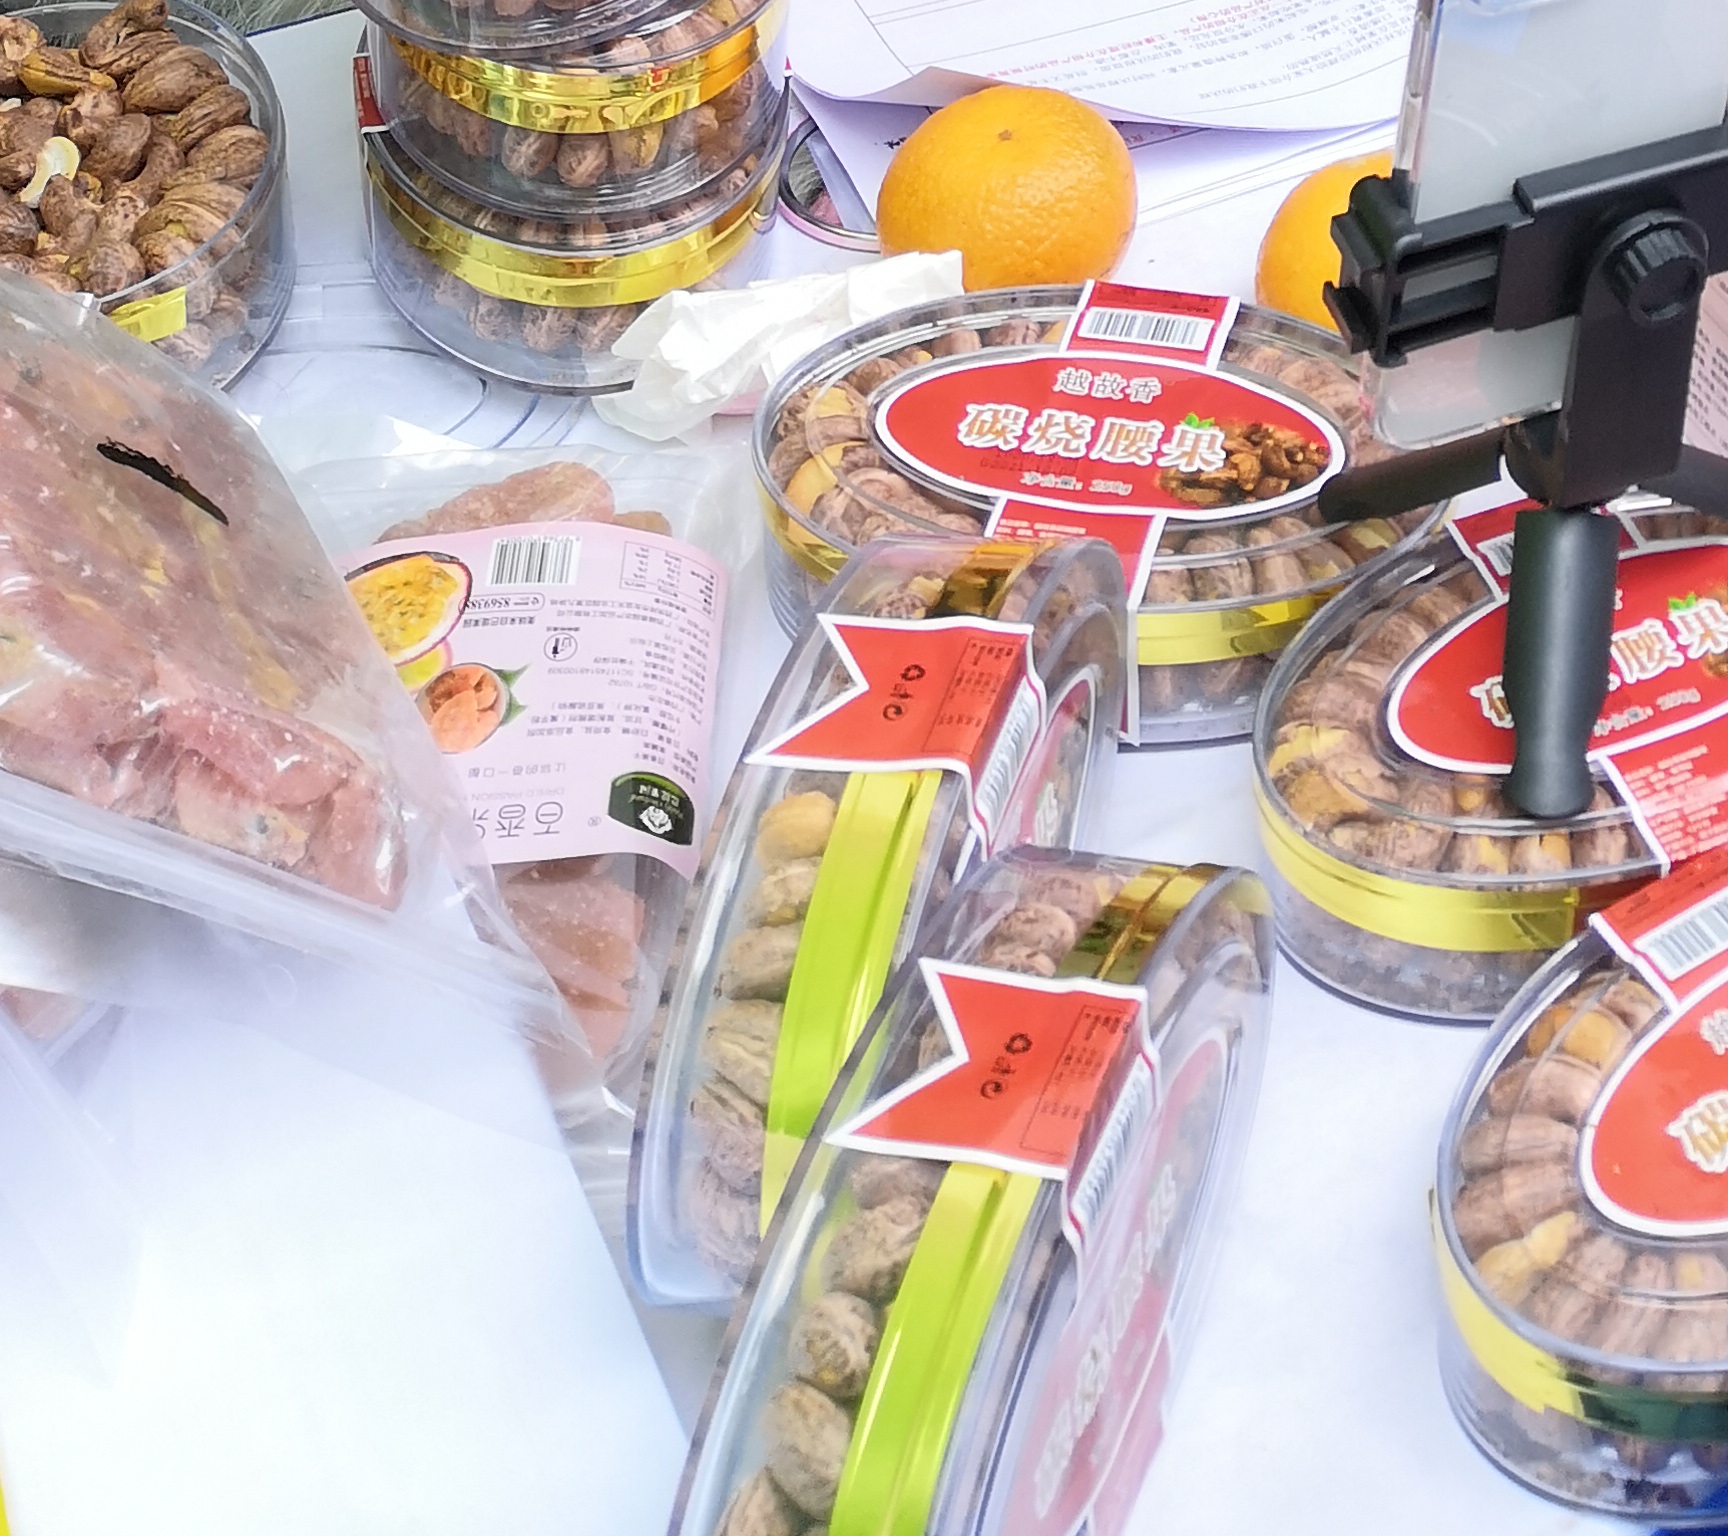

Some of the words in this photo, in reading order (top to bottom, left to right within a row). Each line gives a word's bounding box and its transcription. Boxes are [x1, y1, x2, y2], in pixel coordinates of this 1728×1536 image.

[1053, 366, 1162, 406] 越故香
[956, 401, 1228, 473] 碳烧腰果
